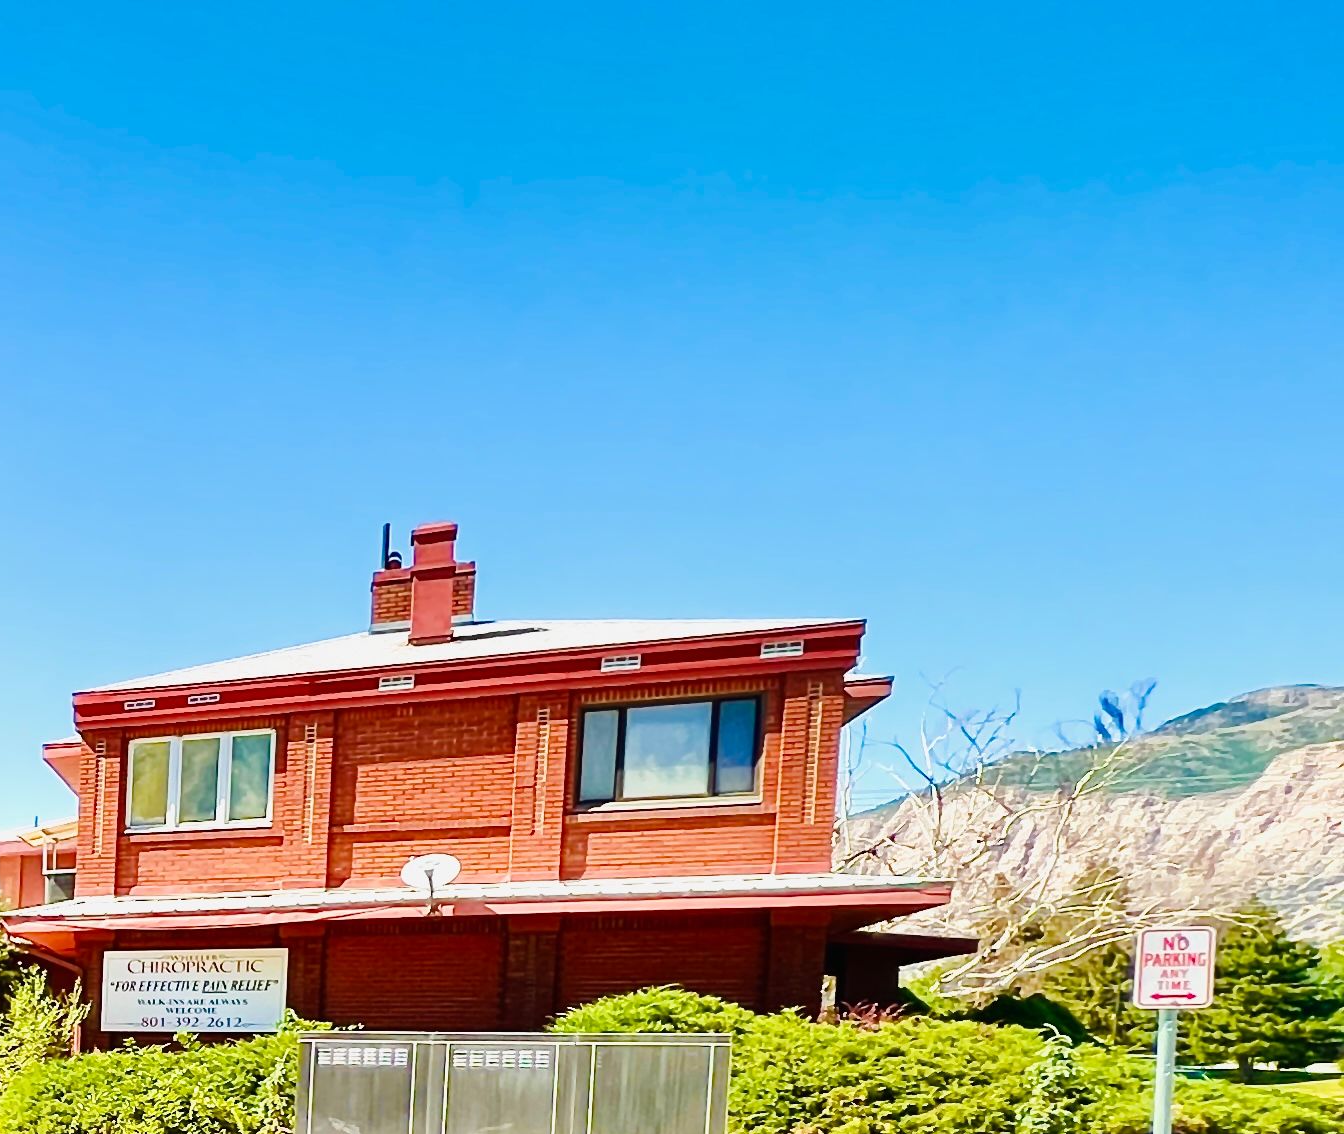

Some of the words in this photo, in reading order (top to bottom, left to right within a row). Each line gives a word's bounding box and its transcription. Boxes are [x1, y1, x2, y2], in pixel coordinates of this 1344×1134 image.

[1162, 935, 1190, 951] NO
[1144, 953, 1206, 967] PARKING
[127, 959, 265, 974] CHIROPRACTIC
[1160, 969, 1190, 979] ANY
[138, 980, 200, 992] EFFECTIVE
[201, 980, 228, 994] PAIN
[1156, 980, 1192, 990] TIME
[208, 998, 249, 1006] ALWAYS
[165, 1007, 217, 1015] WELCOME
[140, 1016, 243, 1028] 801-392-2612
